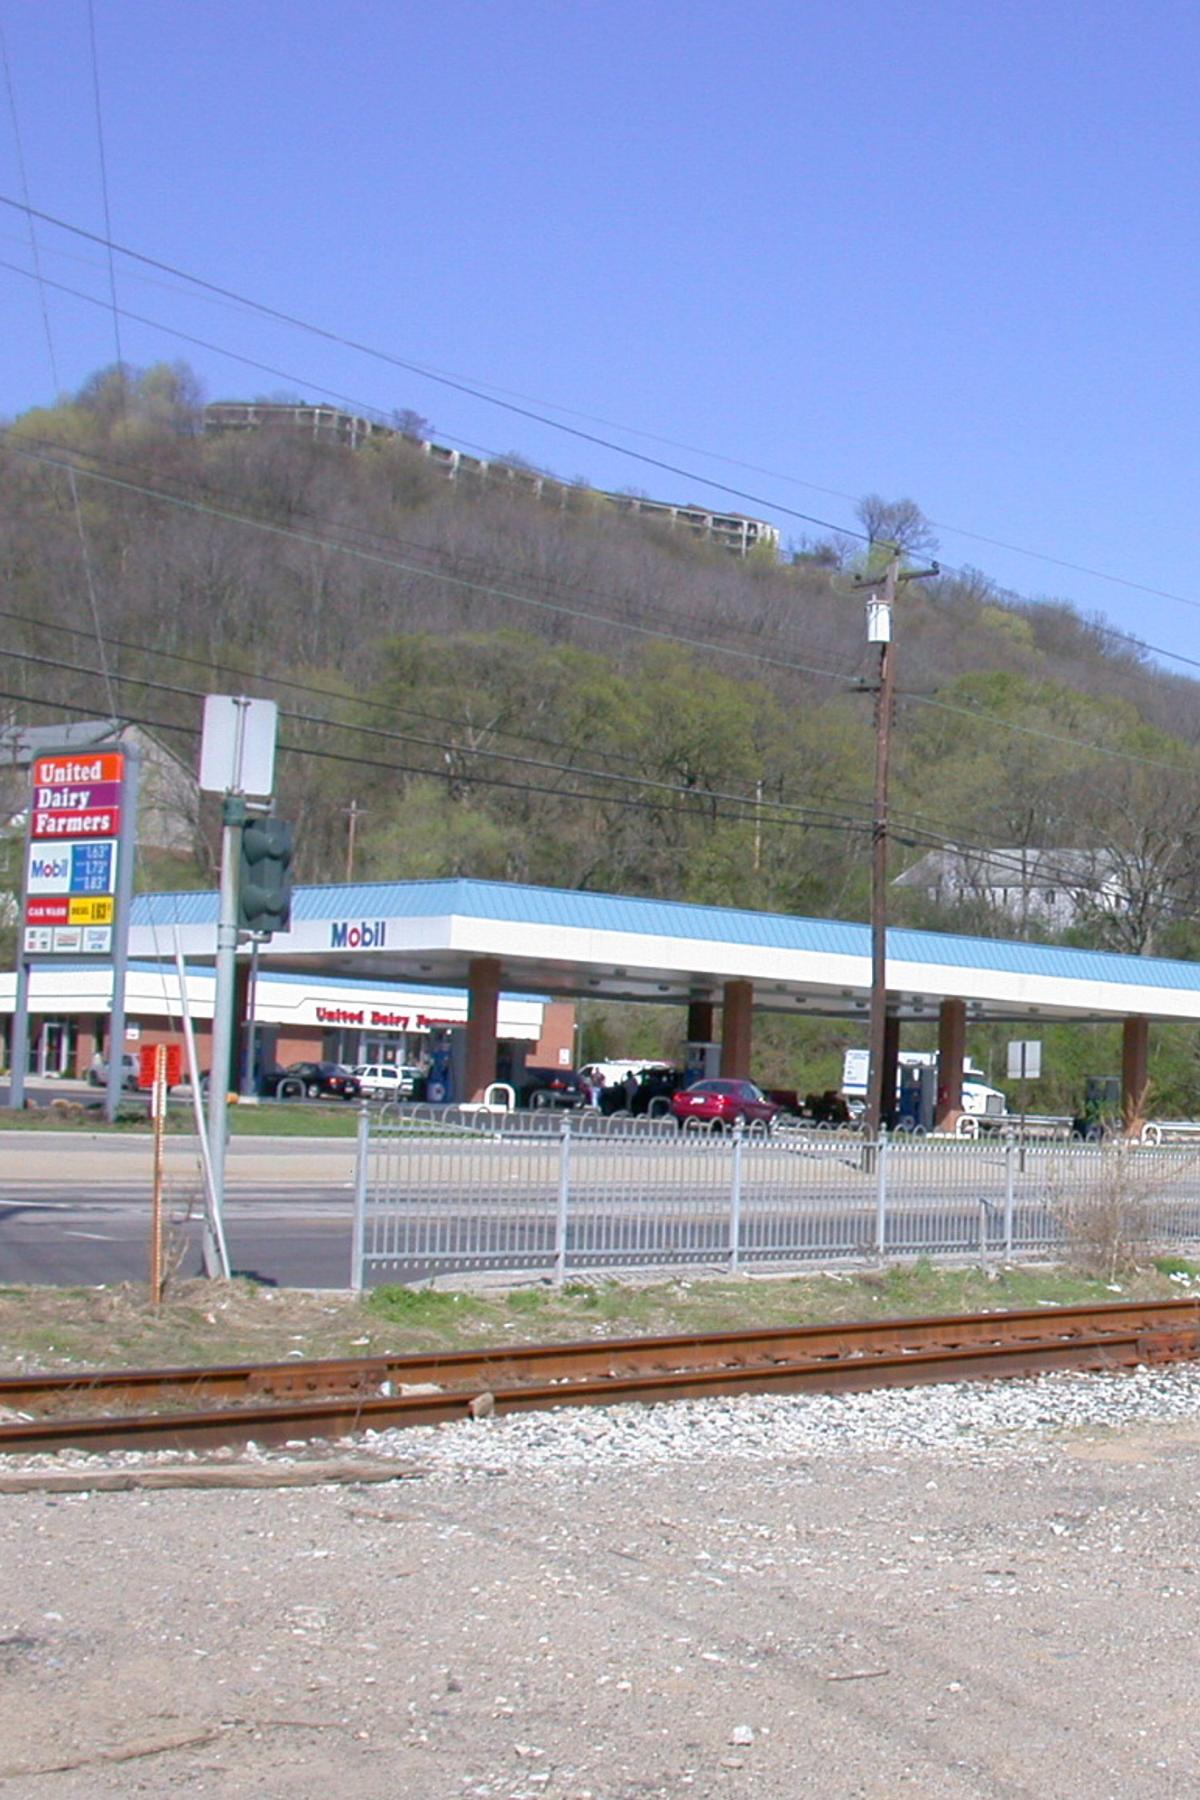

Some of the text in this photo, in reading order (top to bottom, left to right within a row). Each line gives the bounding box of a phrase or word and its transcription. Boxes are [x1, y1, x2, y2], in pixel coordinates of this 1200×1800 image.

[40, 760, 103, 783] United
[37, 788, 91, 810] Dairy
[35, 811, 111, 834] Farmers
[31, 859, 69, 878] Mobil
[331, 921, 386, 948] Mobil
[315, 1007, 365, 1025] United
[371, 1011, 410, 1031] Dairy
